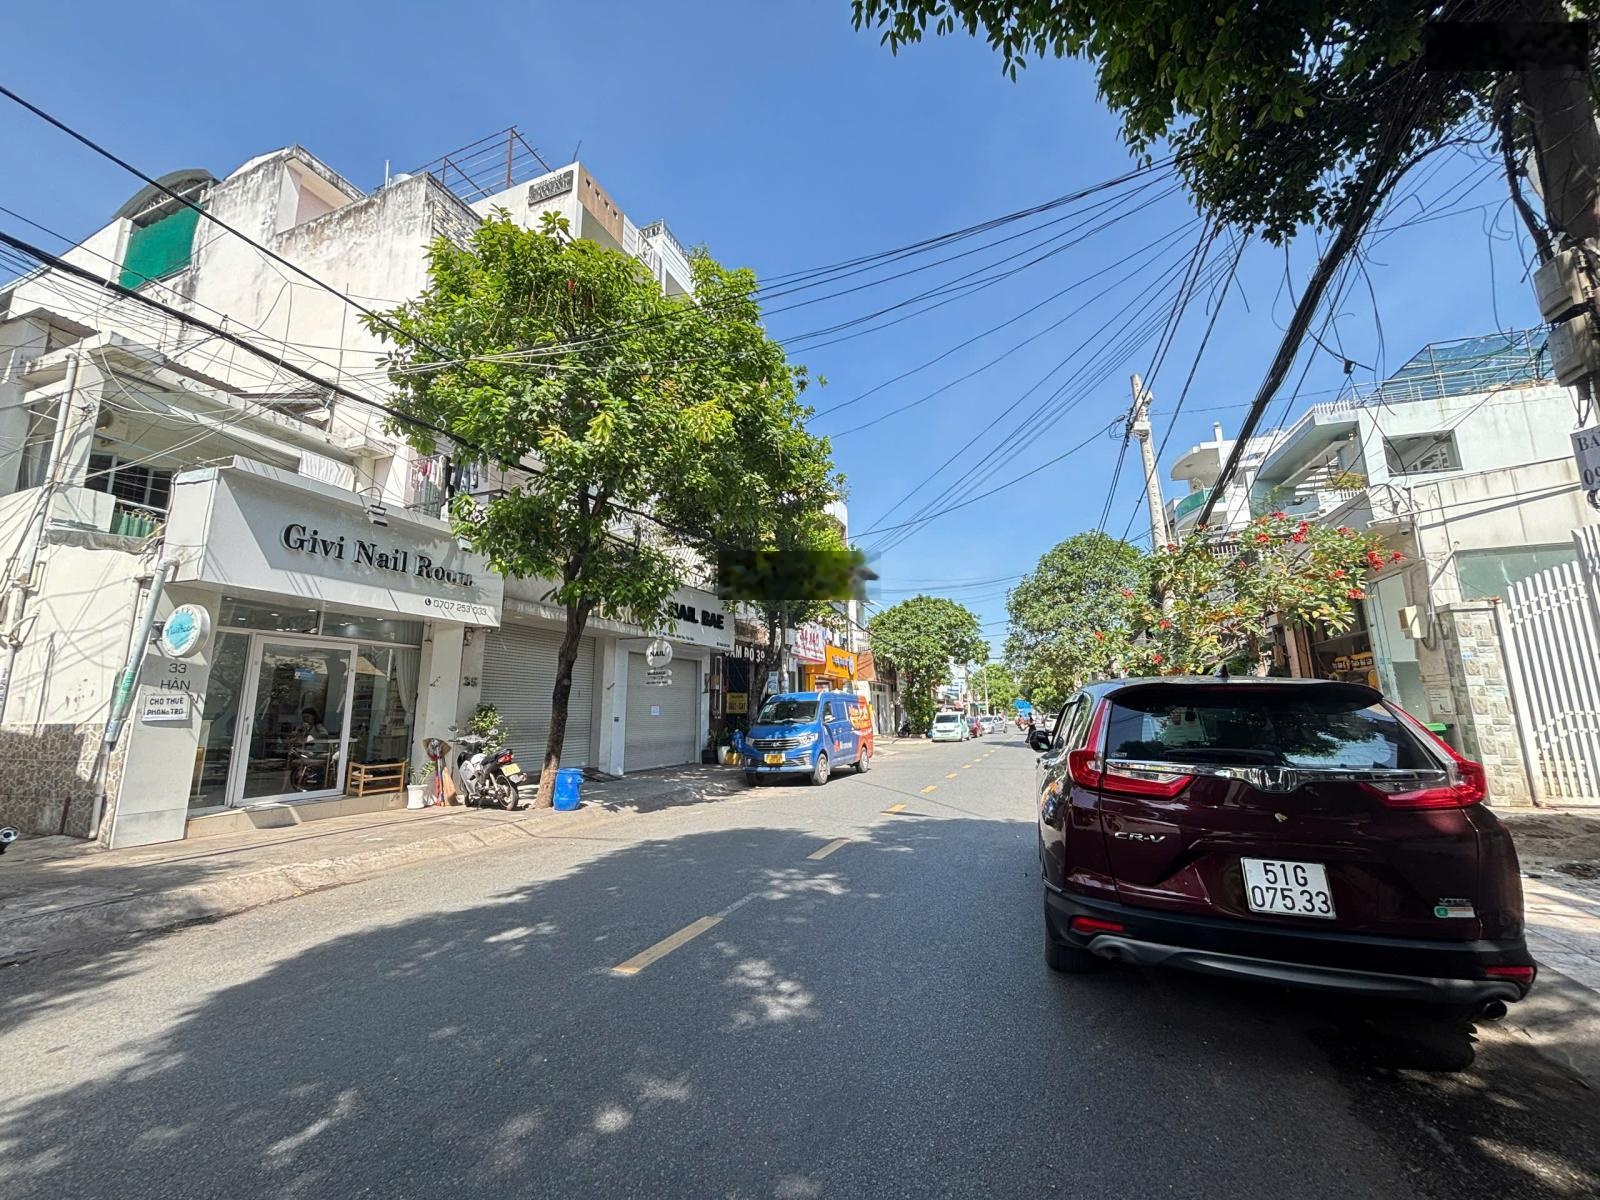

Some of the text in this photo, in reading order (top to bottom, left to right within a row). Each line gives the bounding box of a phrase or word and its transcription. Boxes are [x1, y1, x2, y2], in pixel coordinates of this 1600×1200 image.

[281, 523, 345, 560] Givi
[353, 539, 409, 574] Nail
[433, 600, 455, 610] 0707
[456, 603, 471, 613] 253
[701, 609, 725, 630] BAE
[649, 650, 665, 658] NAIL
[168, 662, 187, 674] 33
[160, 677, 191, 690] HÀN
[149, 697, 164, 706] CHO
[1114, 832, 1166, 843] CR-V
[1262, 862, 1308, 887] 51G
[1251, 885, 1331, 914] 075.33
